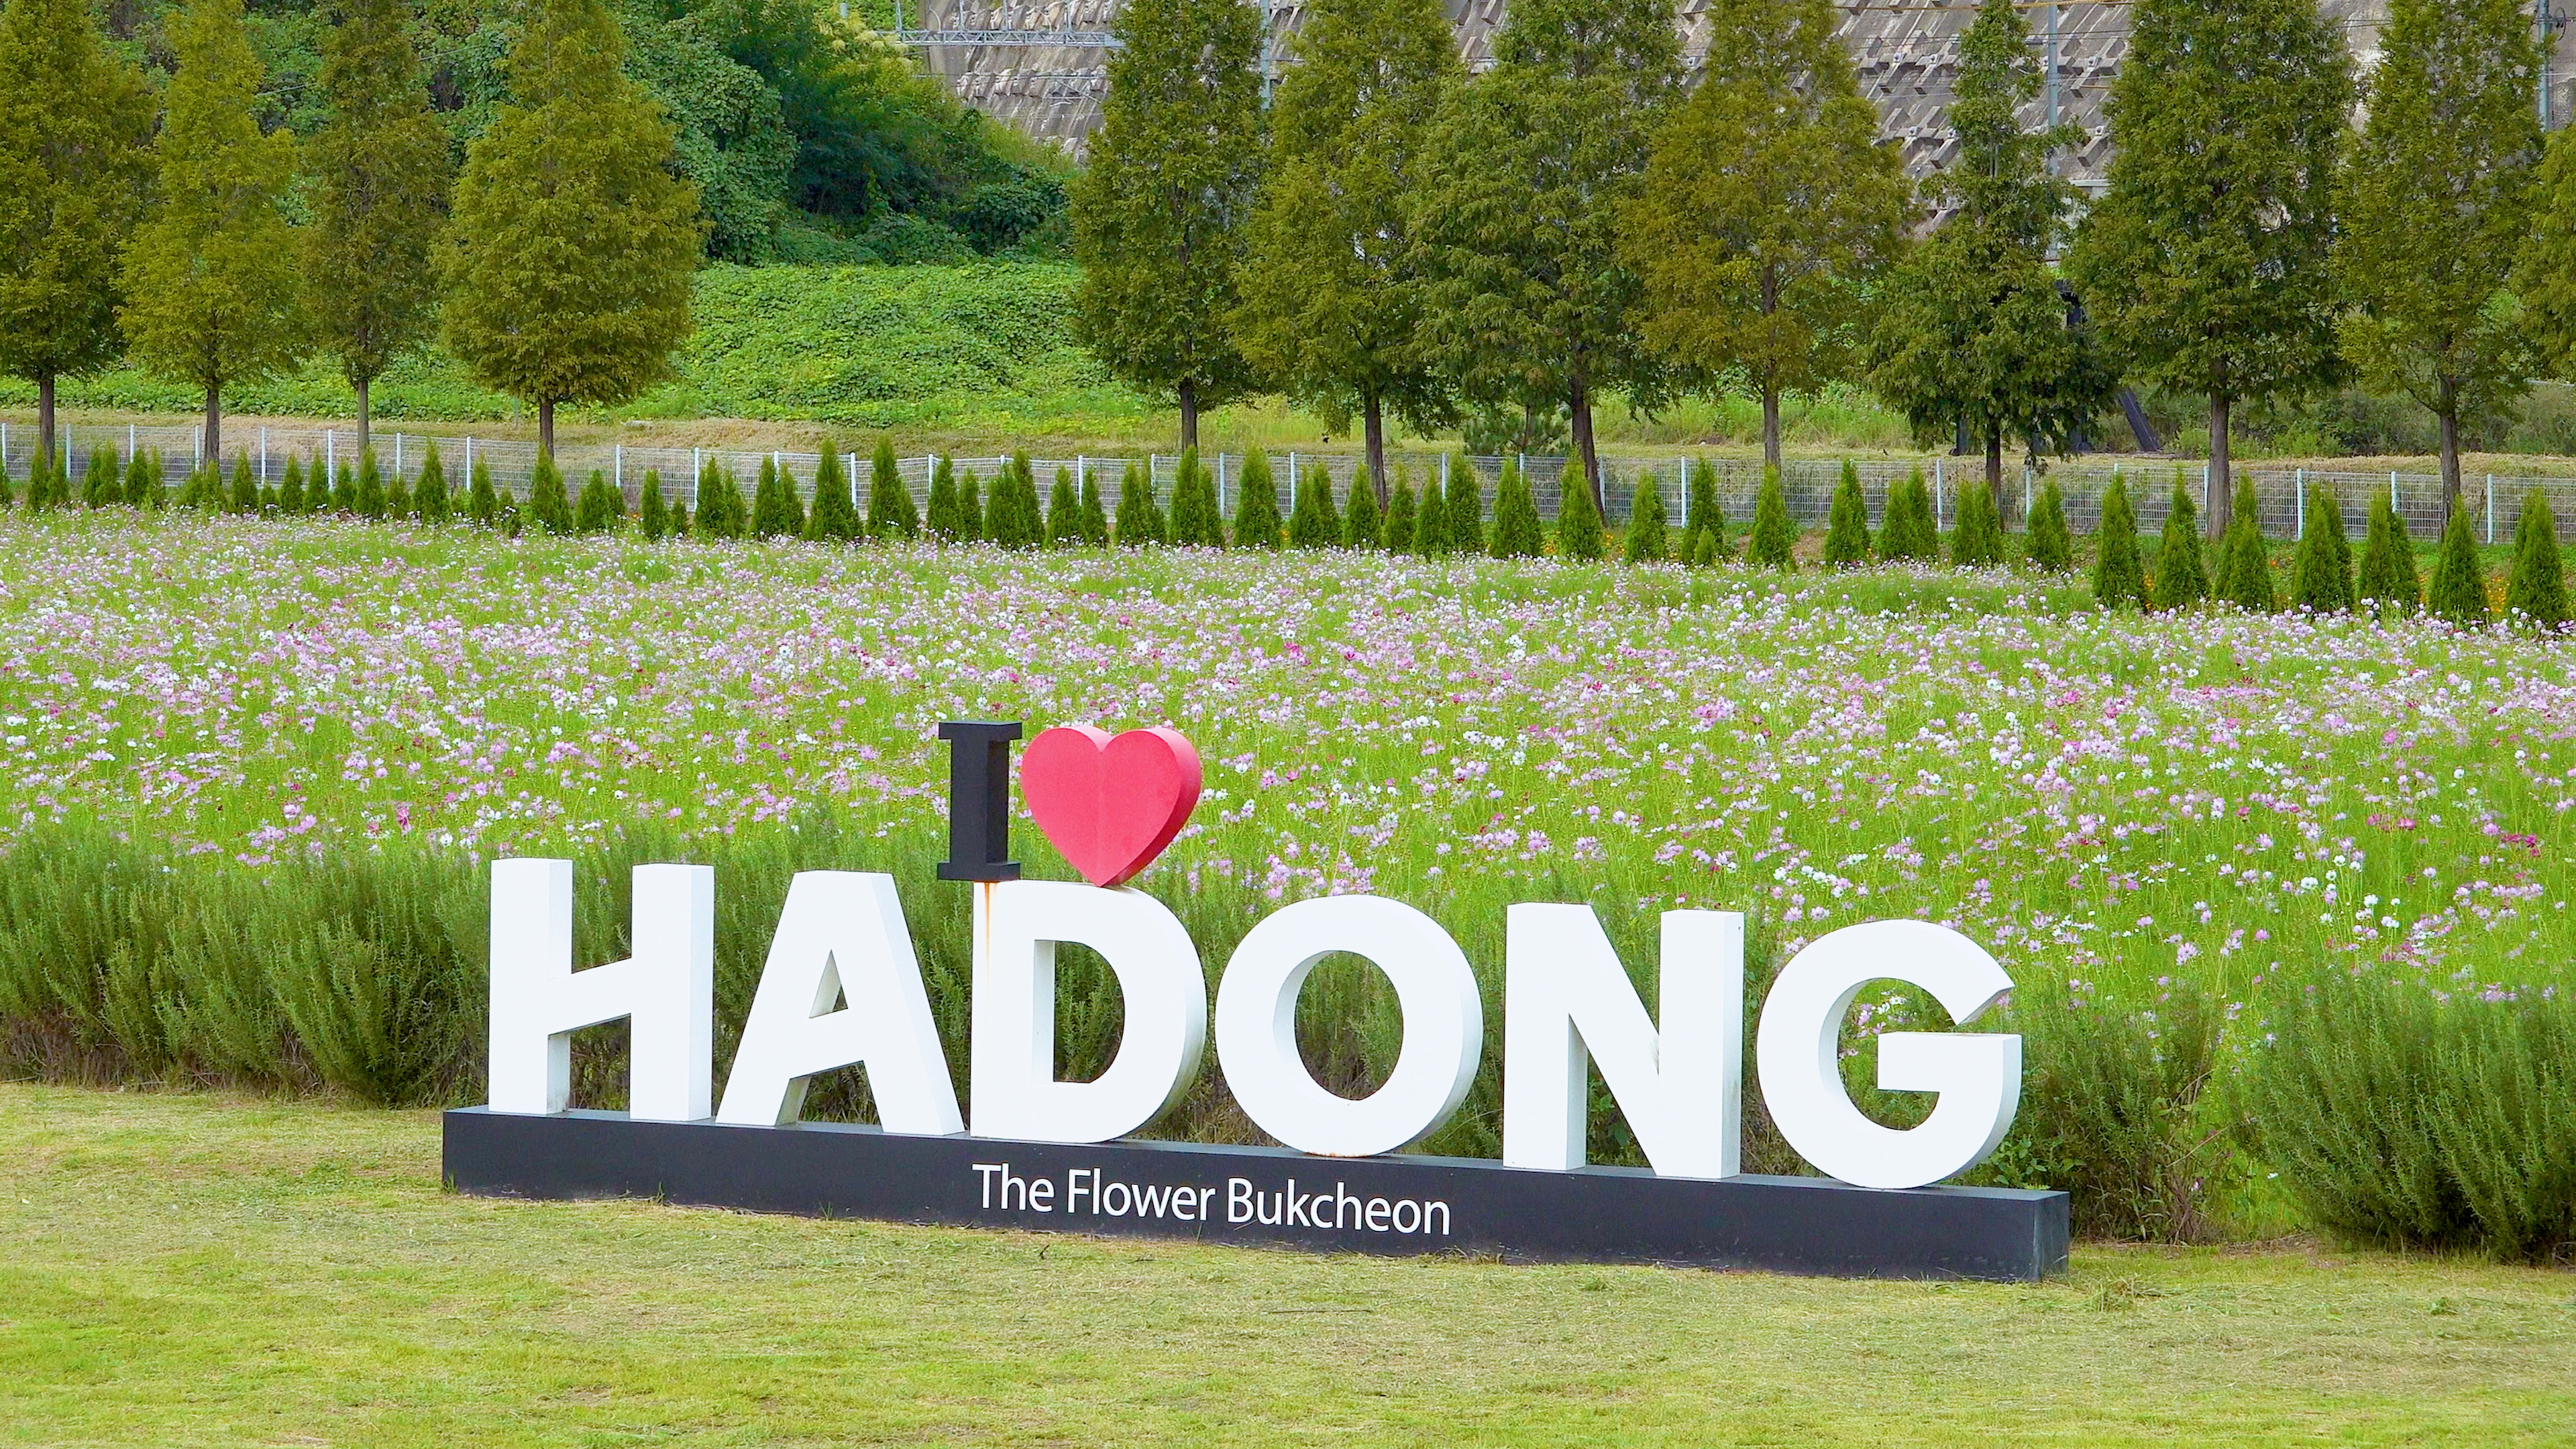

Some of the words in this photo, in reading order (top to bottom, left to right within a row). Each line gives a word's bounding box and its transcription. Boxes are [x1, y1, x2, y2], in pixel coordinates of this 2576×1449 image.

[937, 721, 1022, 881] I
[488, 857, 2022, 1189] HADONG
[972, 1163, 1055, 1213] The
[1068, 1169, 1216, 1221] Flower
[1227, 1177, 1450, 1236] Bukcheon
